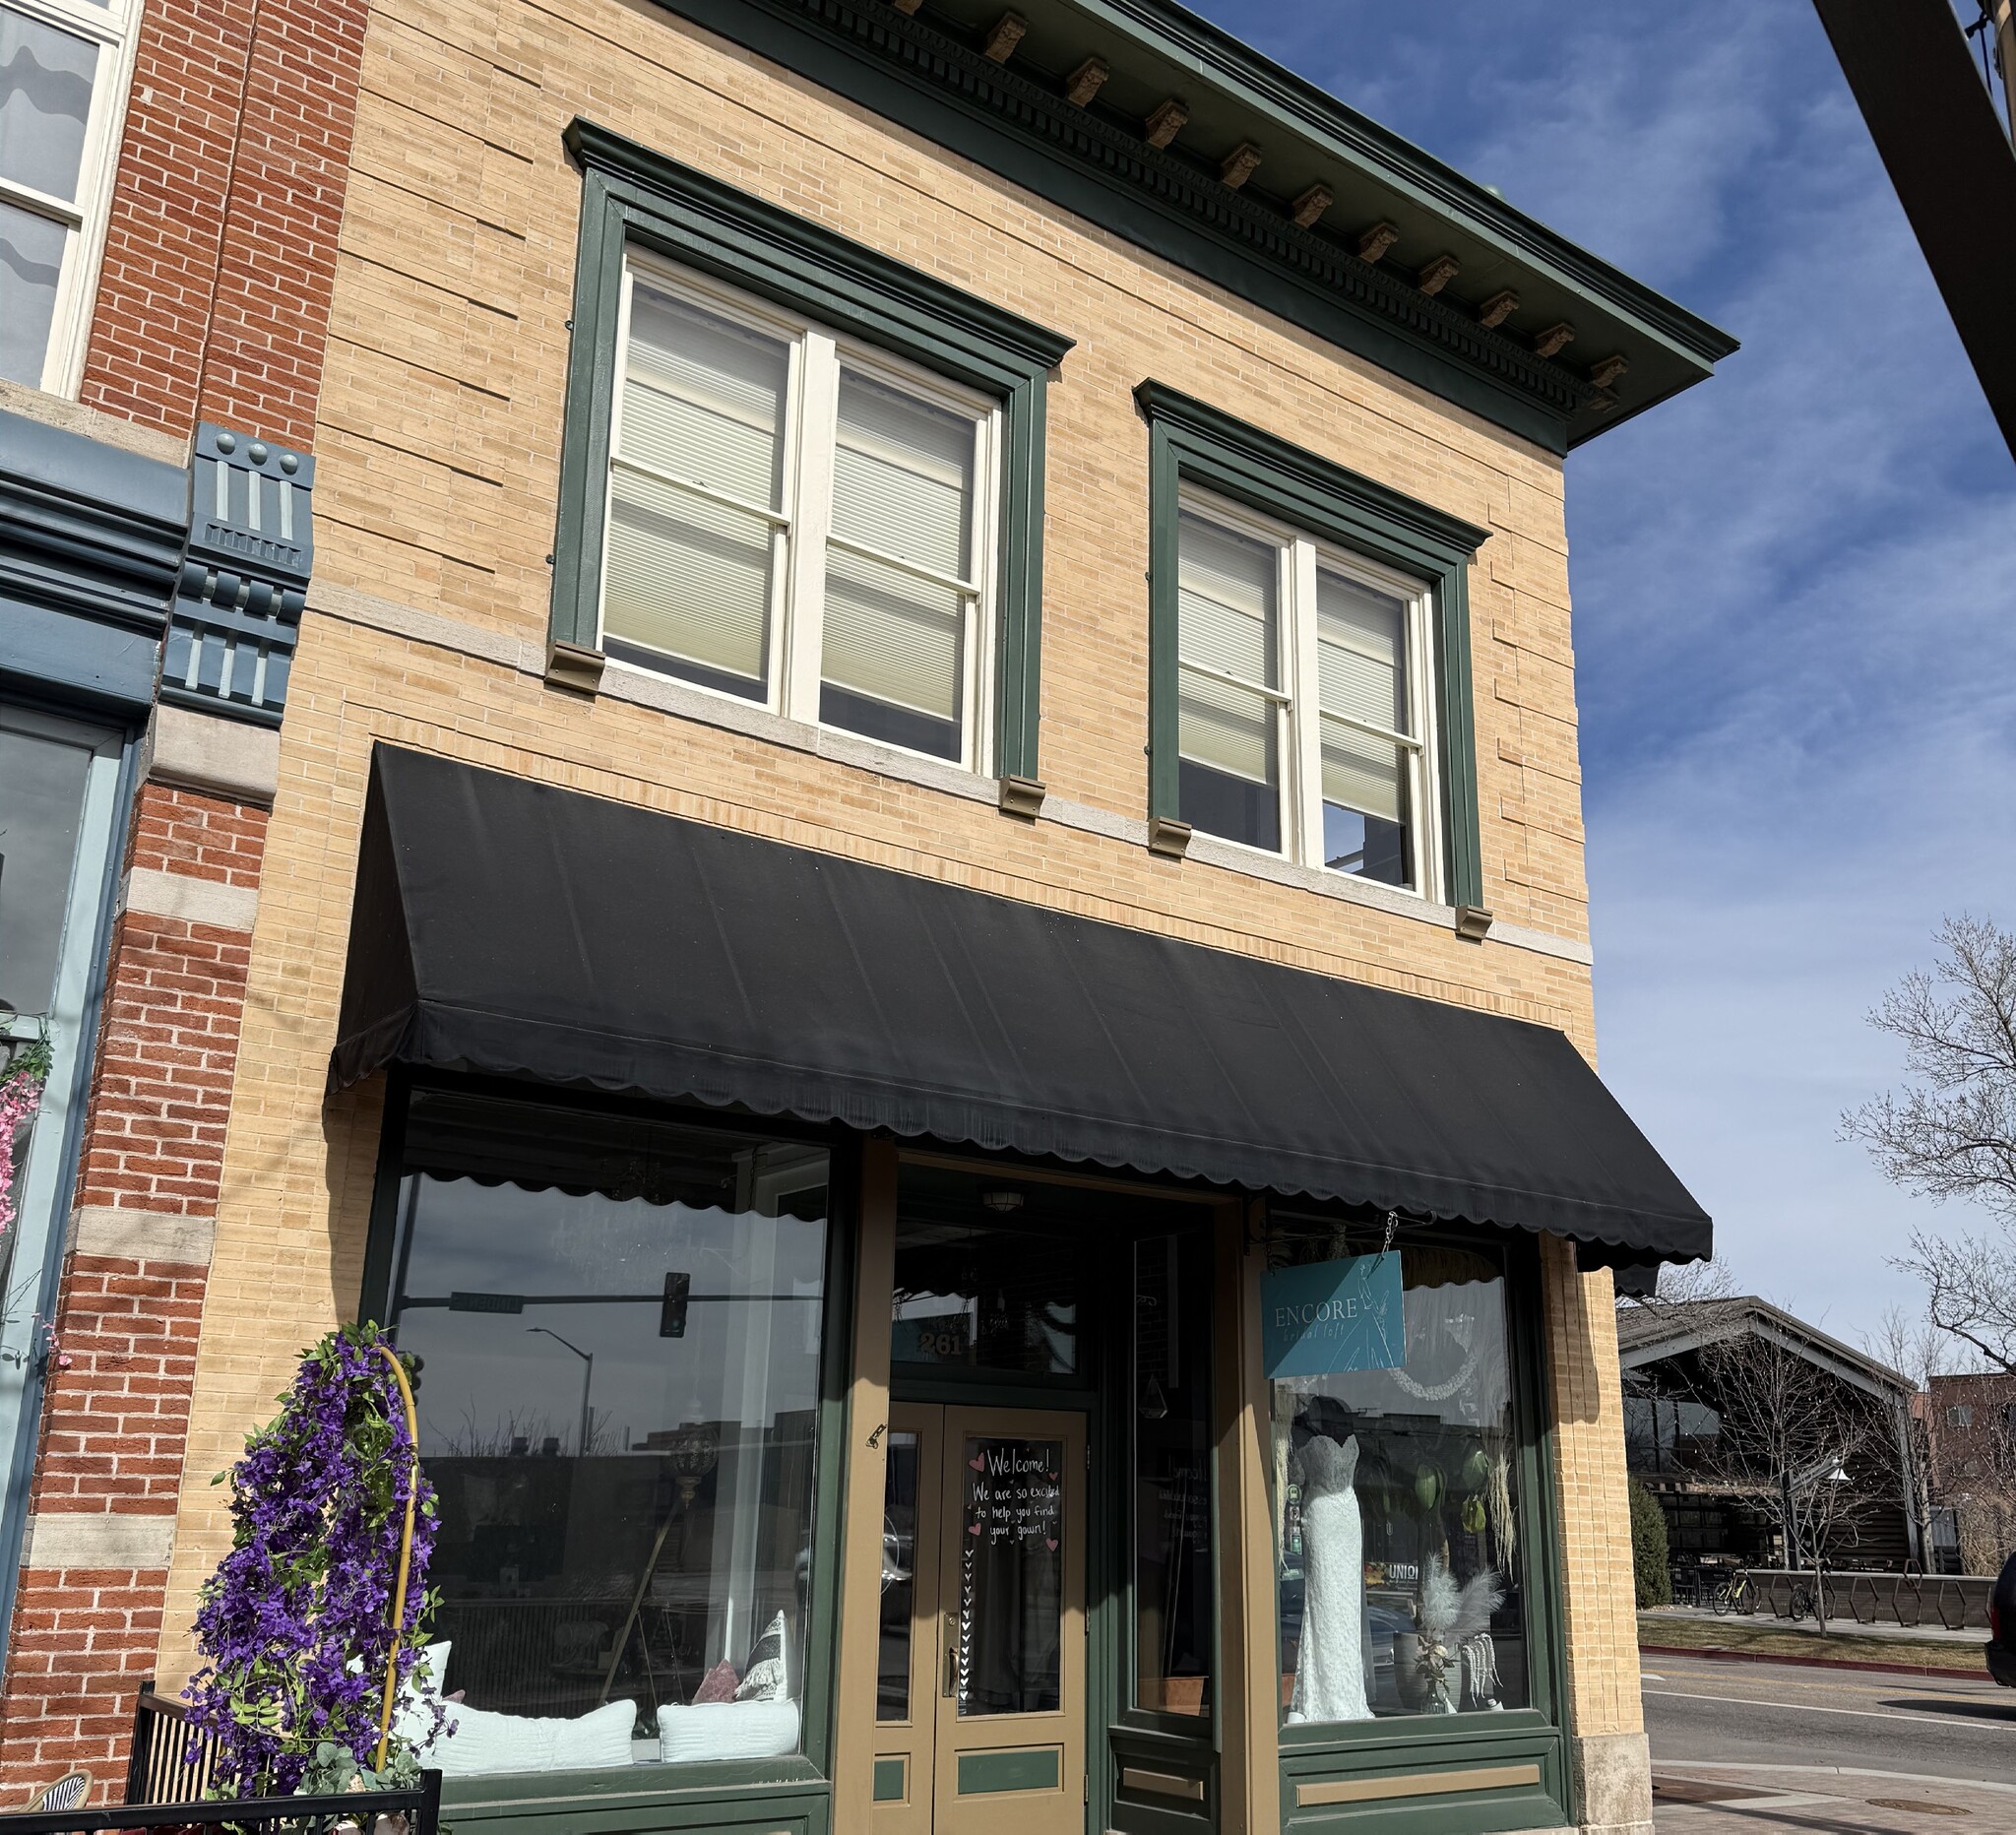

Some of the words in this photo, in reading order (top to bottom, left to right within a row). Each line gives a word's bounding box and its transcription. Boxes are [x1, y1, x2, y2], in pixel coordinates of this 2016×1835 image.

[1275, 1297, 1357, 1327] ENCORE
[1323, 1322, 1345, 1340] loft
[919, 1332, 962, 1355] 261
[987, 1447, 1049, 1477] Welcome!
[973, 1482, 989, 1501] We
[994, 1489, 1012, 1500] are
[1016, 1488, 1028, 1499] so
[1030, 1485, 1060, 1498] excited
[976, 1506, 986, 1519] to
[992, 1506, 1011, 1522] help
[1016, 1508, 1031, 1524] you
[1034, 1505, 1054, 1516] find
[990, 1526, 1009, 1545] your
[1018, 1521, 1046, 1541] gown!
